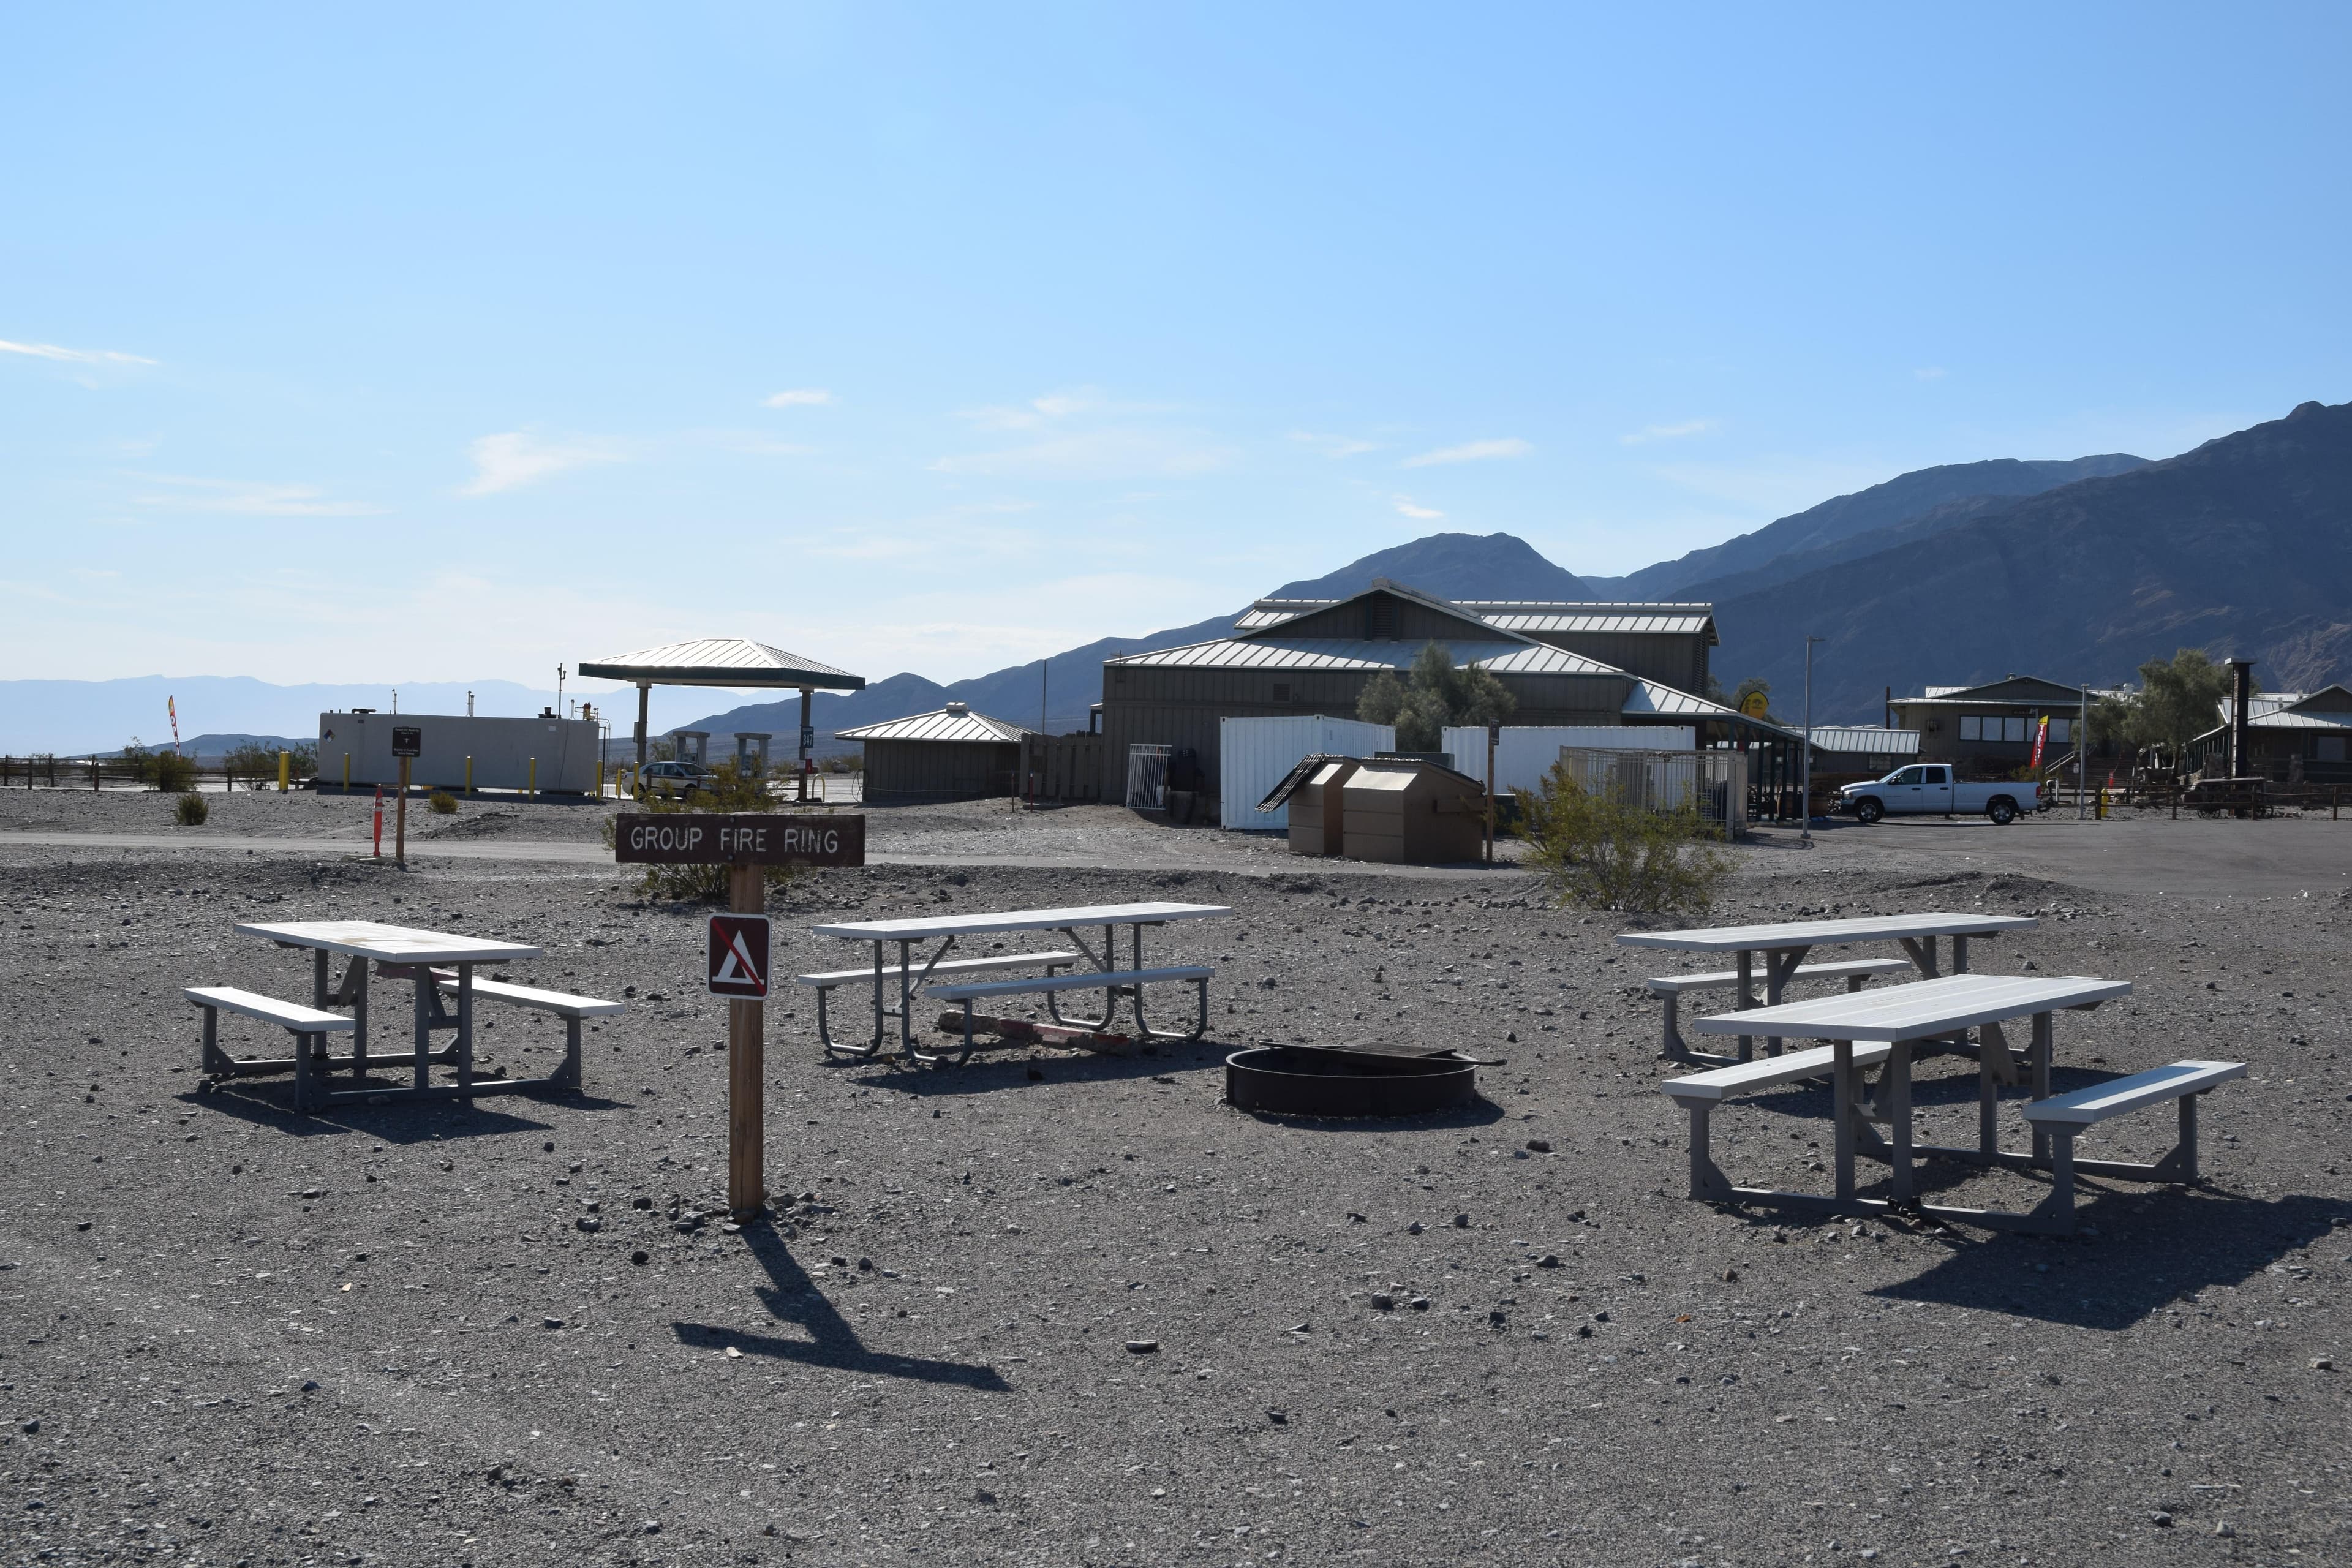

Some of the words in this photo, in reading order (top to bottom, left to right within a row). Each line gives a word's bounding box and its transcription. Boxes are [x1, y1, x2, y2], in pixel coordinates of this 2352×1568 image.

[631, 826, 703, 850] GROUP
[720, 828, 767, 852] FIRE
[784, 829, 838, 853] RING
